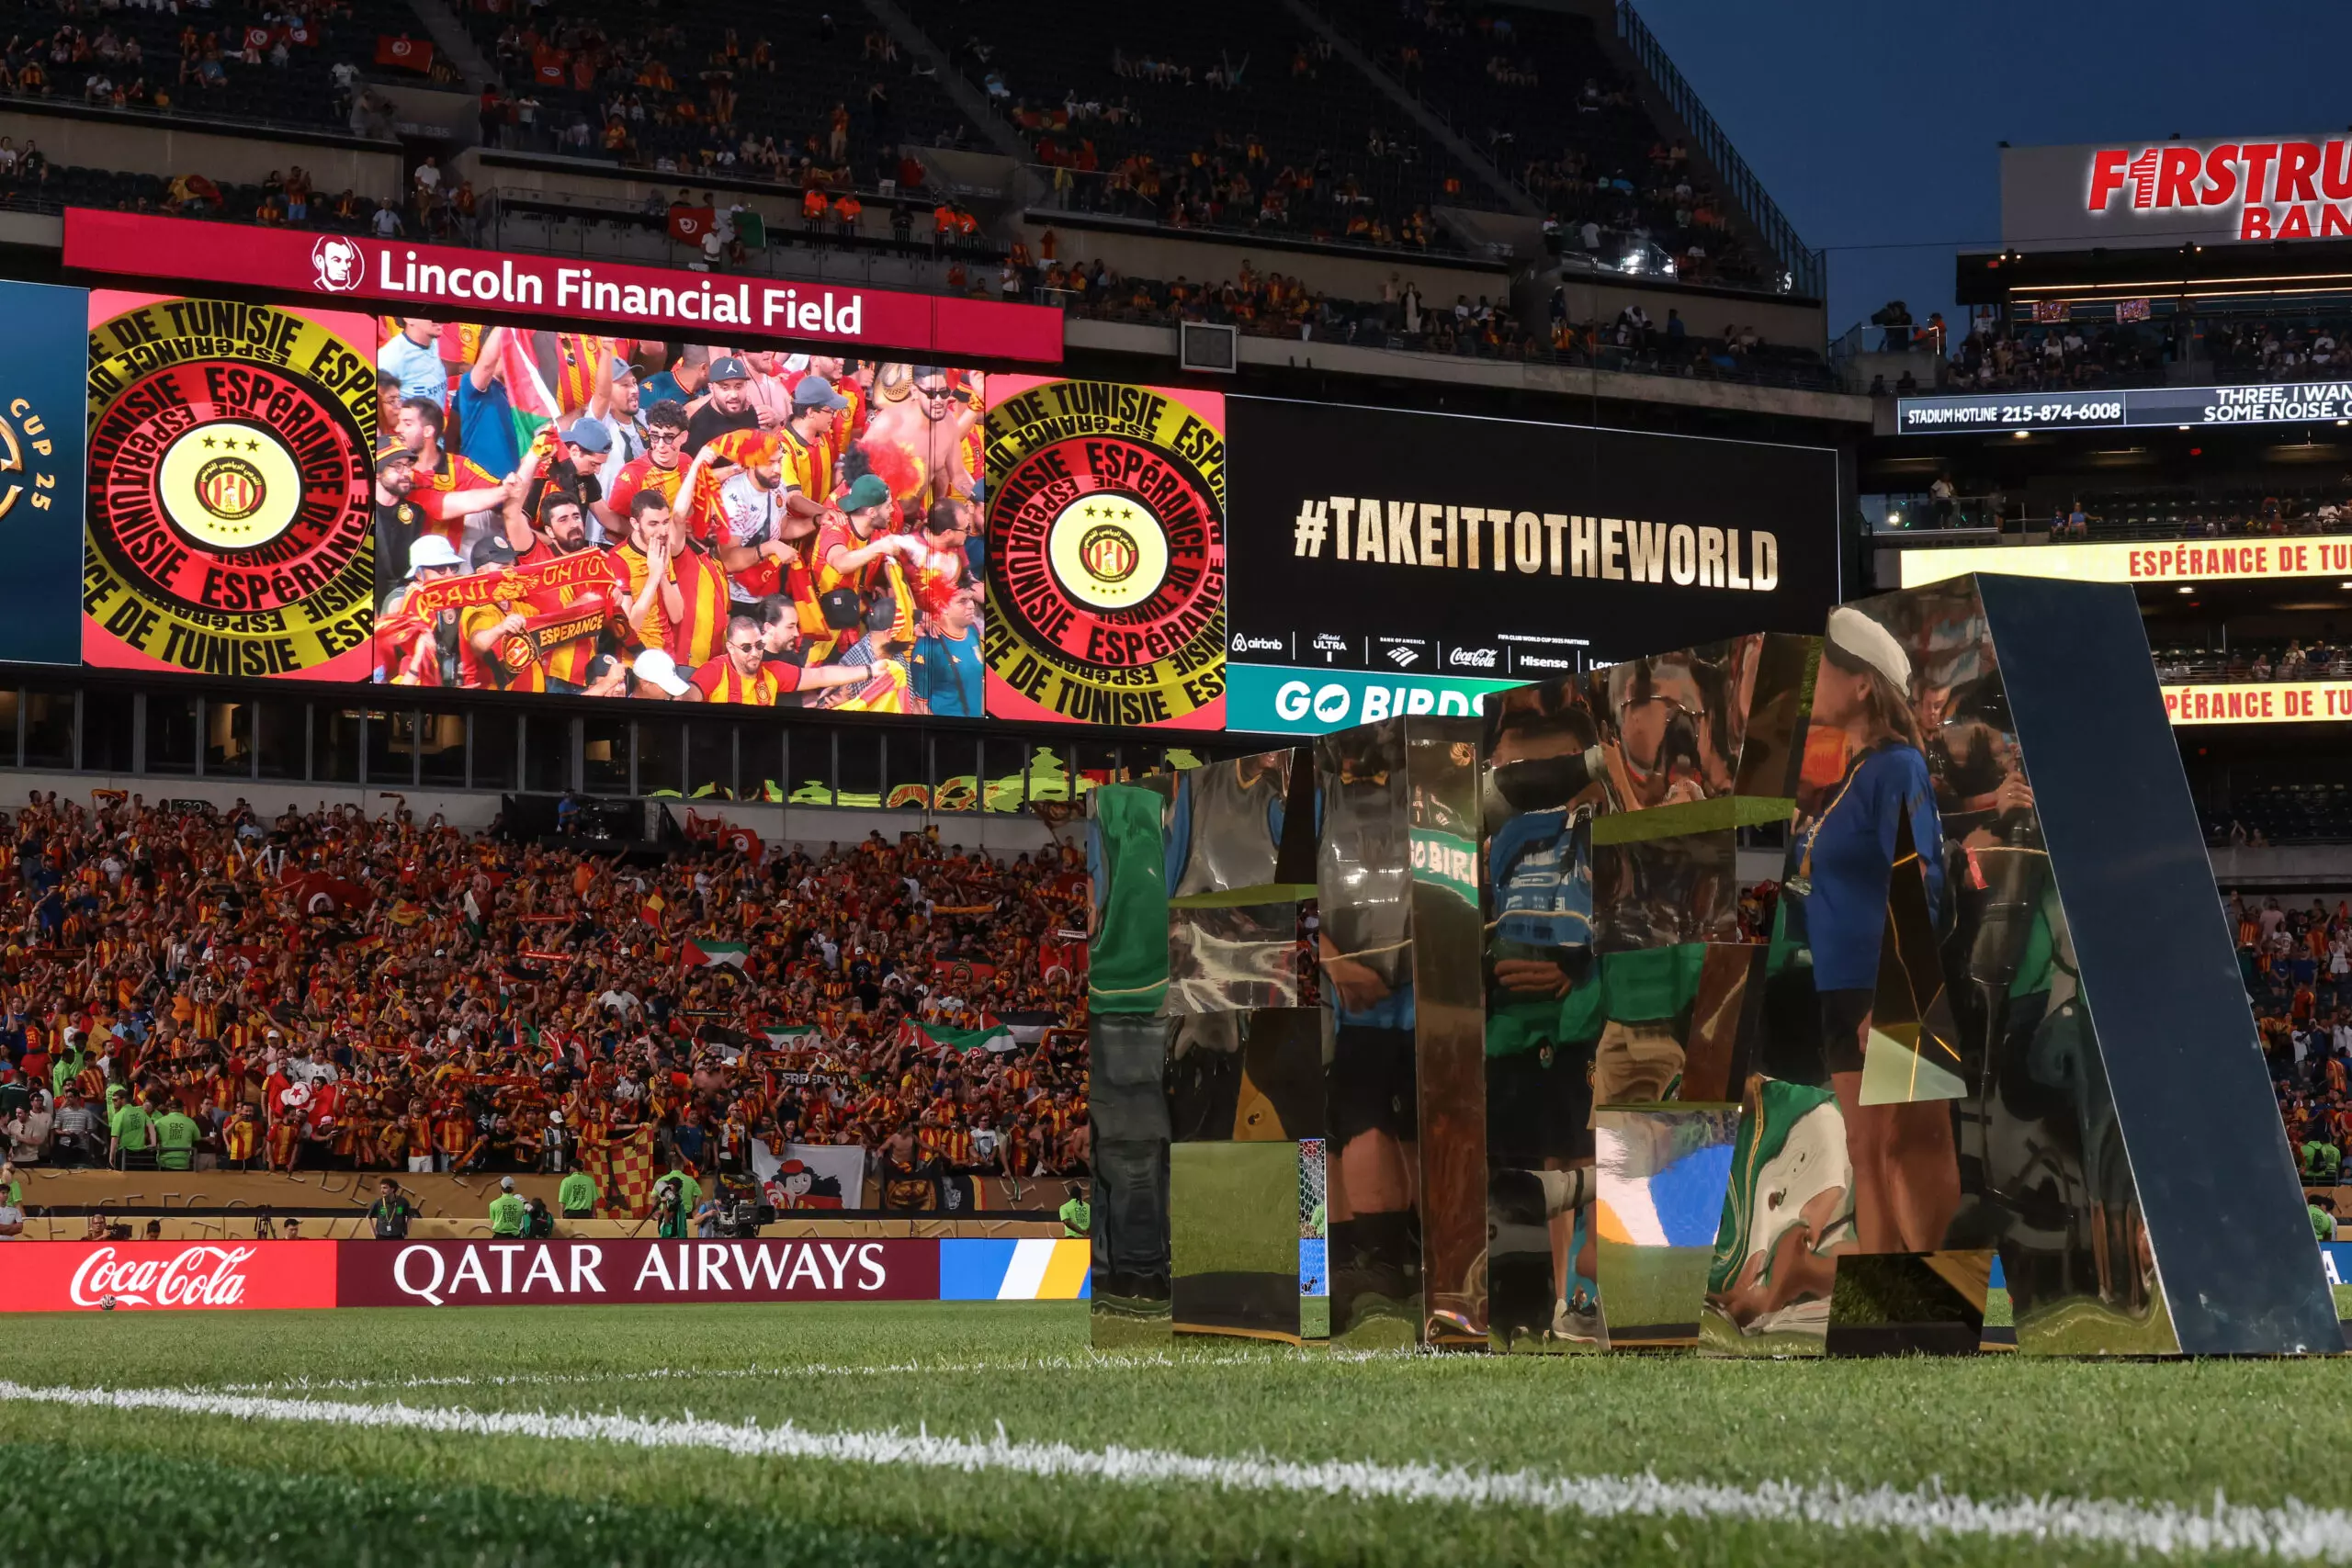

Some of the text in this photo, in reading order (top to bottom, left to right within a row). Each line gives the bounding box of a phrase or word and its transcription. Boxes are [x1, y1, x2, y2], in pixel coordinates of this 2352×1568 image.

[2088, 141, 2352, 210] F1RSTRU
[2241, 203, 2352, 240] BAN
[380, 251, 862, 335] Lincoln Financial Field
[107, 310, 164, 349] DE
[164, 300, 305, 356] TUNISIE
[1003, 390, 1049, 427] DE
[1050, 382, 1167, 434] TUNISIE
[2205, 404, 2266, 422] SOME
[2268, 401, 2337, 420] NOISE.
[2303, 384, 2352, 402] WAN
[1908, 402, 2121, 424] STADIUM HOTLINE 215-874-6008
[10, 398, 55, 512] CUP 25
[1294, 495, 1780, 592] #TAKEITTOTHEWORLD
[2129, 544, 2267, 577] ESPÉRANCE
[2278, 545, 2308, 572] DE
[102, 596, 162, 652] DE
[161, 621, 303, 676] TUNISIE
[538, 614, 605, 648] ESPERANCE
[1248, 637, 1283, 650] airbnb
[1313, 639, 1348, 651] ULTRA
[1449, 647, 1498, 667] Coca-Cola
[1520, 655, 1568, 669] Hisense
[1004, 653, 1051, 704] DE
[1054, 681, 1171, 726] TUNISIE
[1275, 681, 1351, 723] GO
[2165, 687, 2272, 720] PÉRANCE
[2284, 690, 2313, 717] DE
[70, 1246, 257, 1307] Coca-Cola
[393, 1243, 886, 1305] QATAR AIRWAYS
